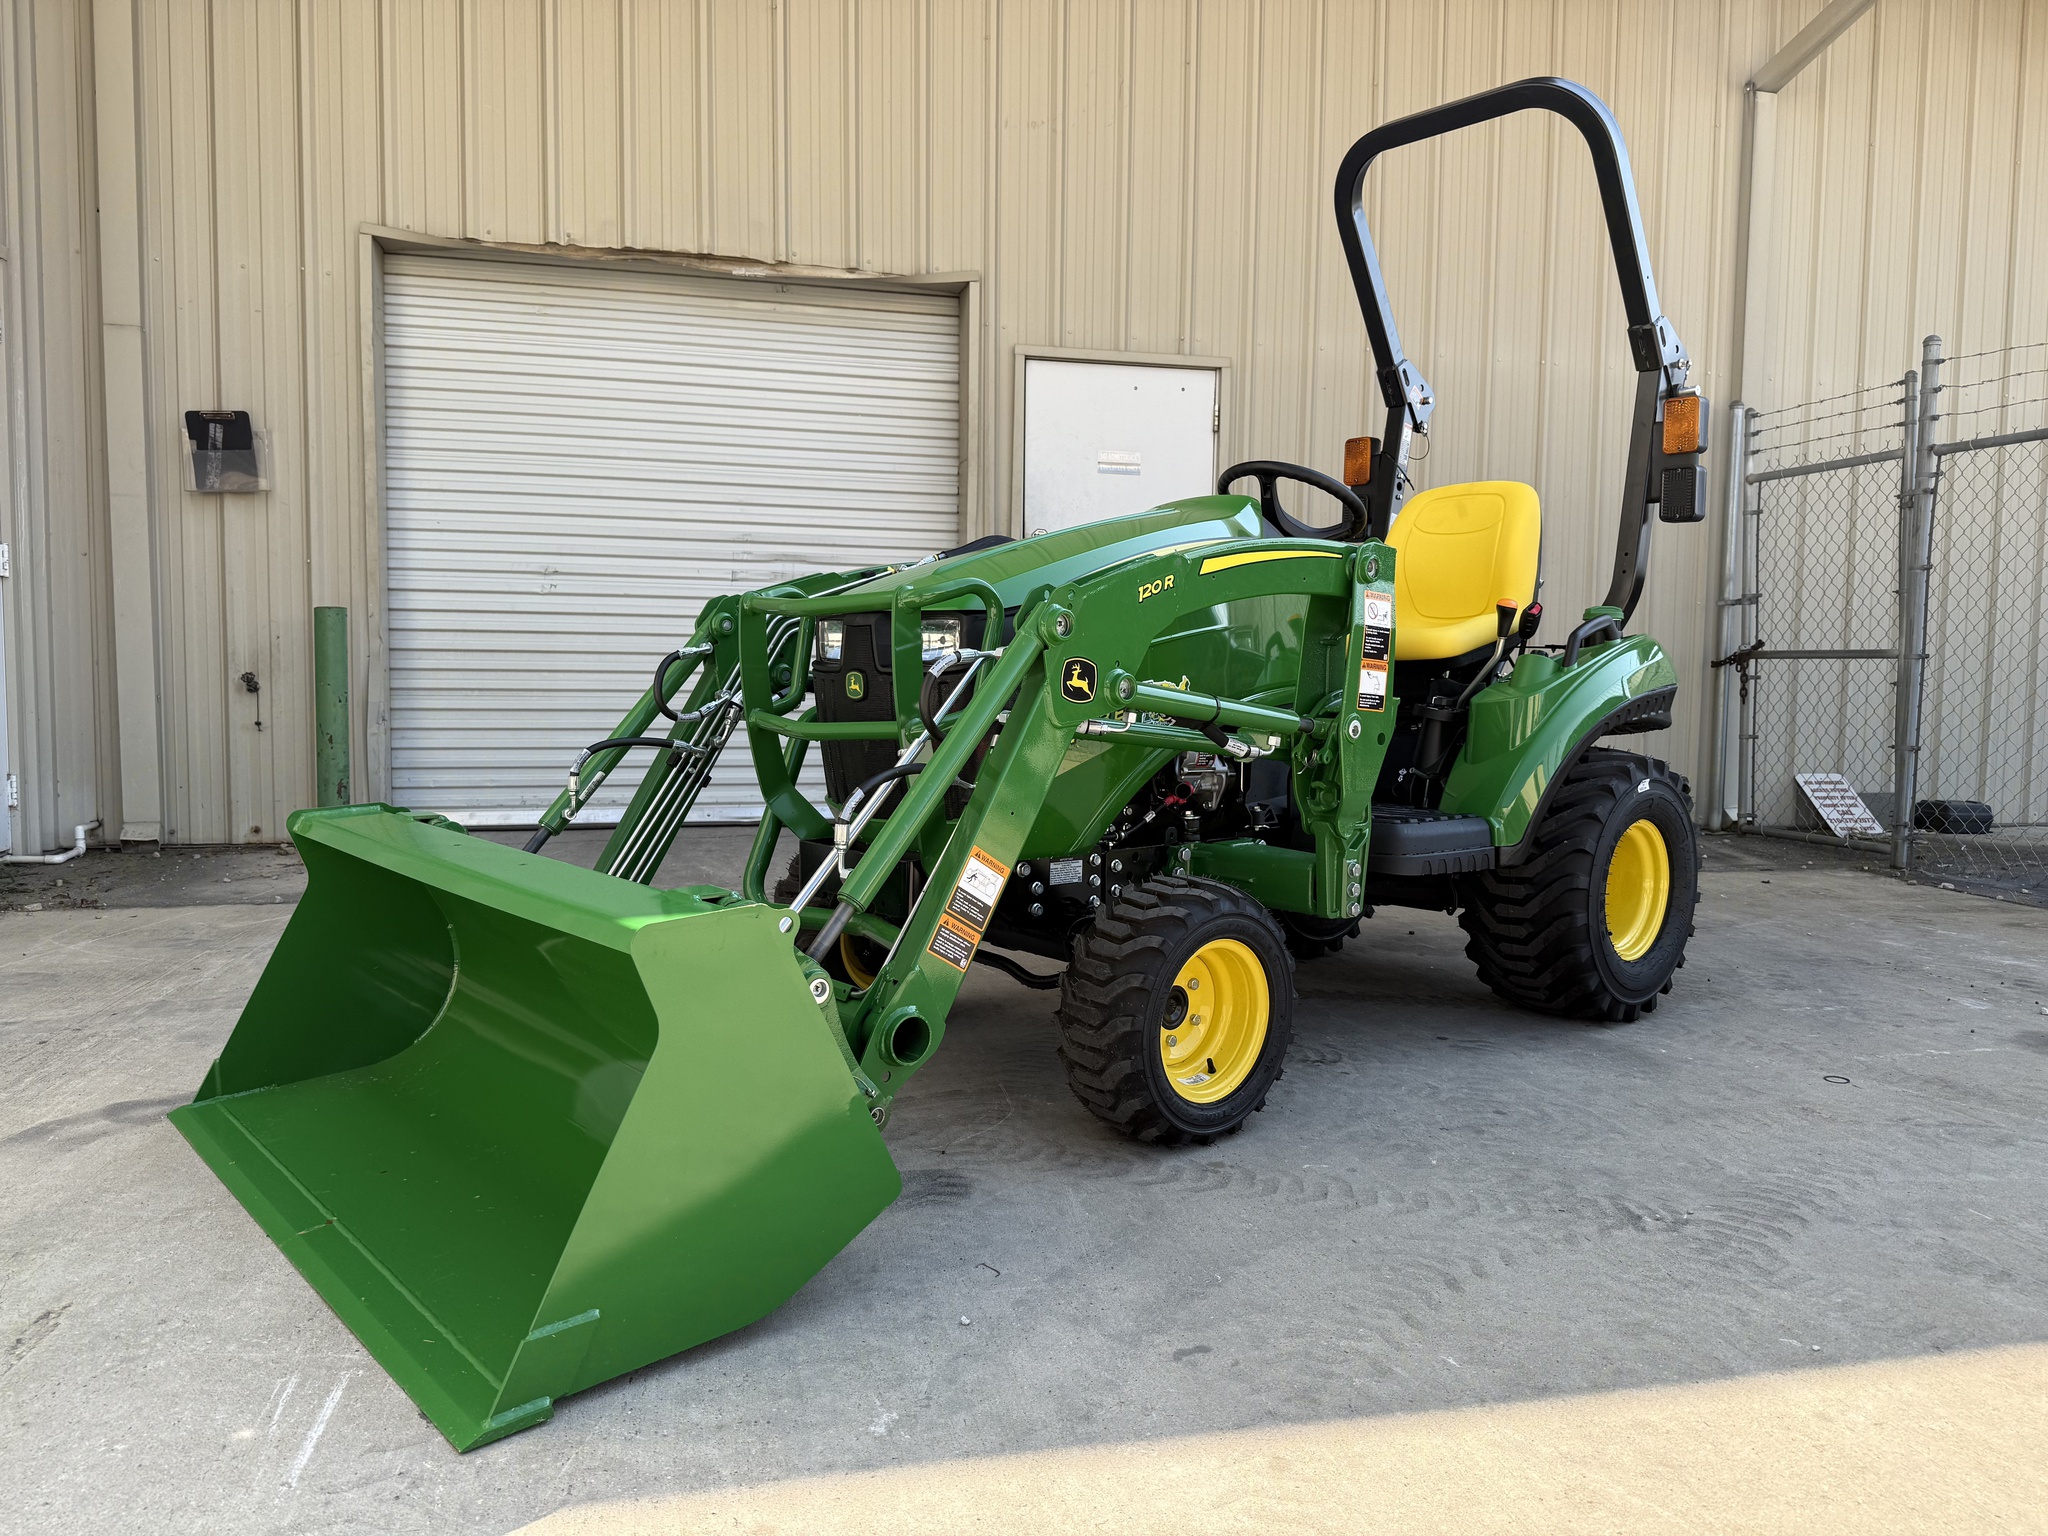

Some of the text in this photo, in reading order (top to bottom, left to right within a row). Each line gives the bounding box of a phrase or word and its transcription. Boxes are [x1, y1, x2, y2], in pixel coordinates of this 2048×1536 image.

[1370, 592, 1391, 602] WARNING
[1366, 663, 1387, 671] WARNING
[981, 853, 1005, 875] WARNING
[951, 922, 976, 941] WARNING
